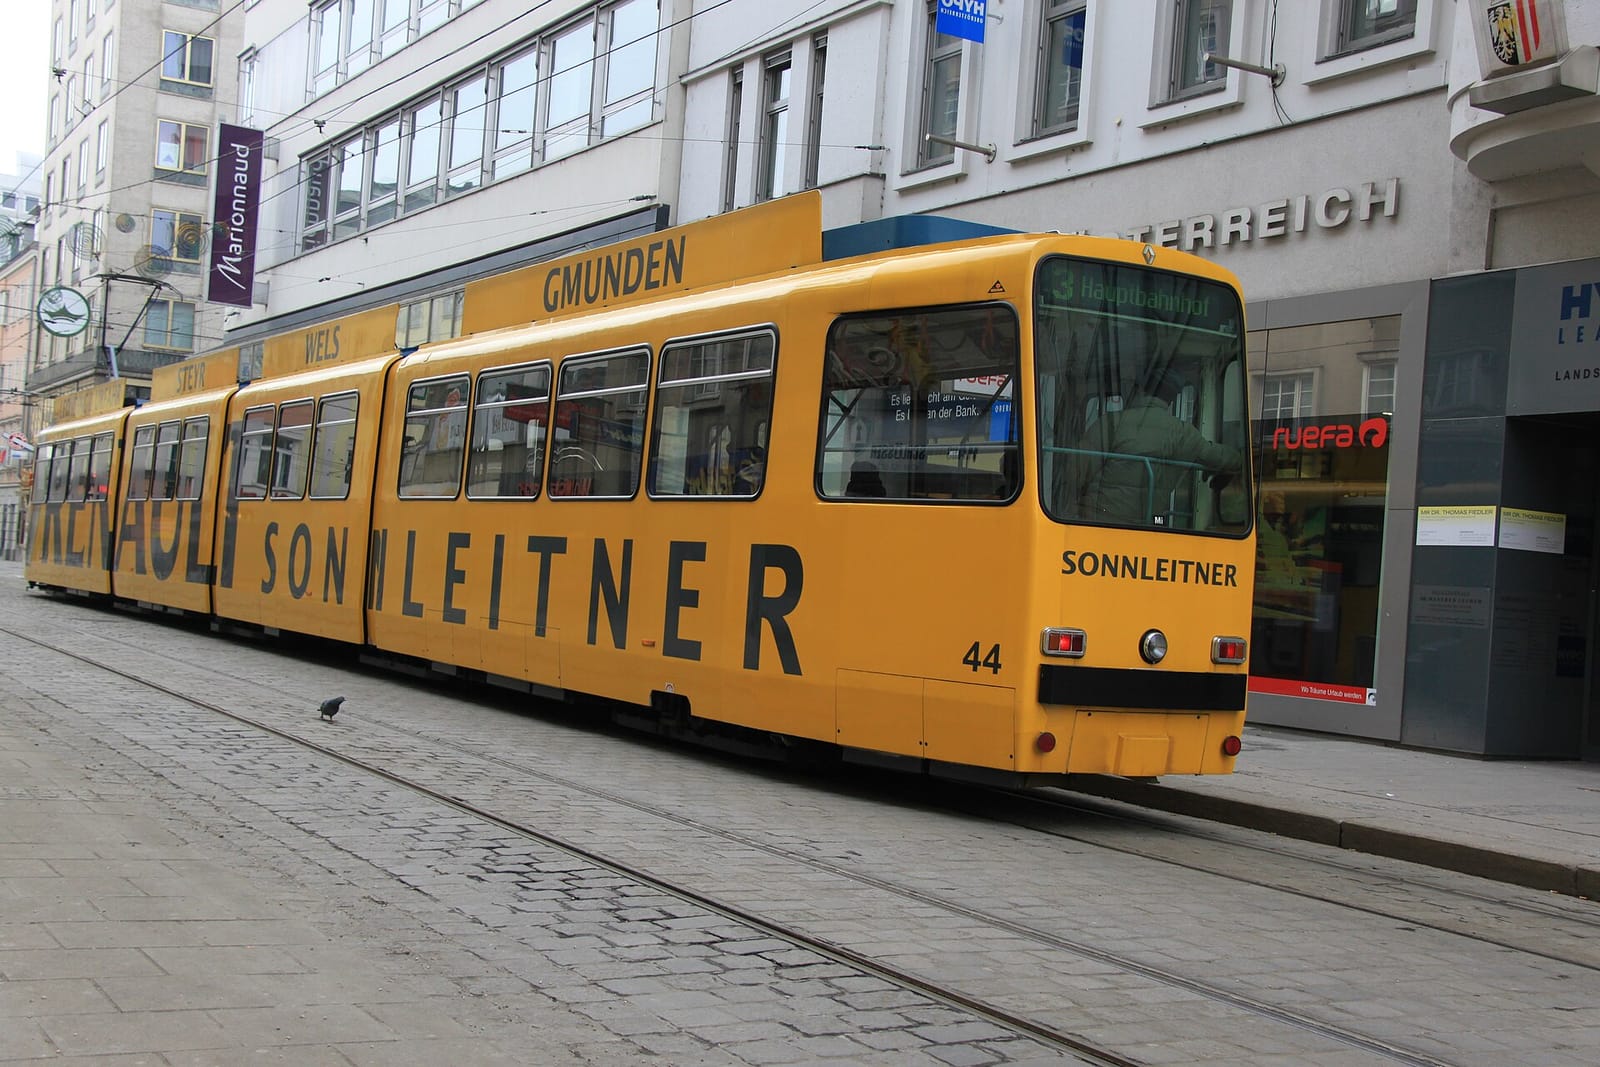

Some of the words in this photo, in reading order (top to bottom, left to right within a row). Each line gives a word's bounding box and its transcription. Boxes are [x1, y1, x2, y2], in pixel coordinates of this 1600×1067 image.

[217, 143, 249, 290] Marionnaud
[543, 235, 686, 313] GMUNDEN
[1052, 268, 1074, 300] 3
[1081, 275, 1210, 317] Hauptbahnhof
[1560, 282, 1600, 320] H
[305, 325, 341, 365] WELS
[177, 362, 206, 393] STEYR
[938, 406, 952, 419] der
[955, 404, 979, 417] Bank.
[1272, 424, 1353, 450] ruefa
[1154, 516, 1164, 525] Mi
[1061, 550, 1237, 587] SONNLEITNER
[261, 521, 804, 675] SONNLEITNER
[962, 641, 1002, 675] 44
